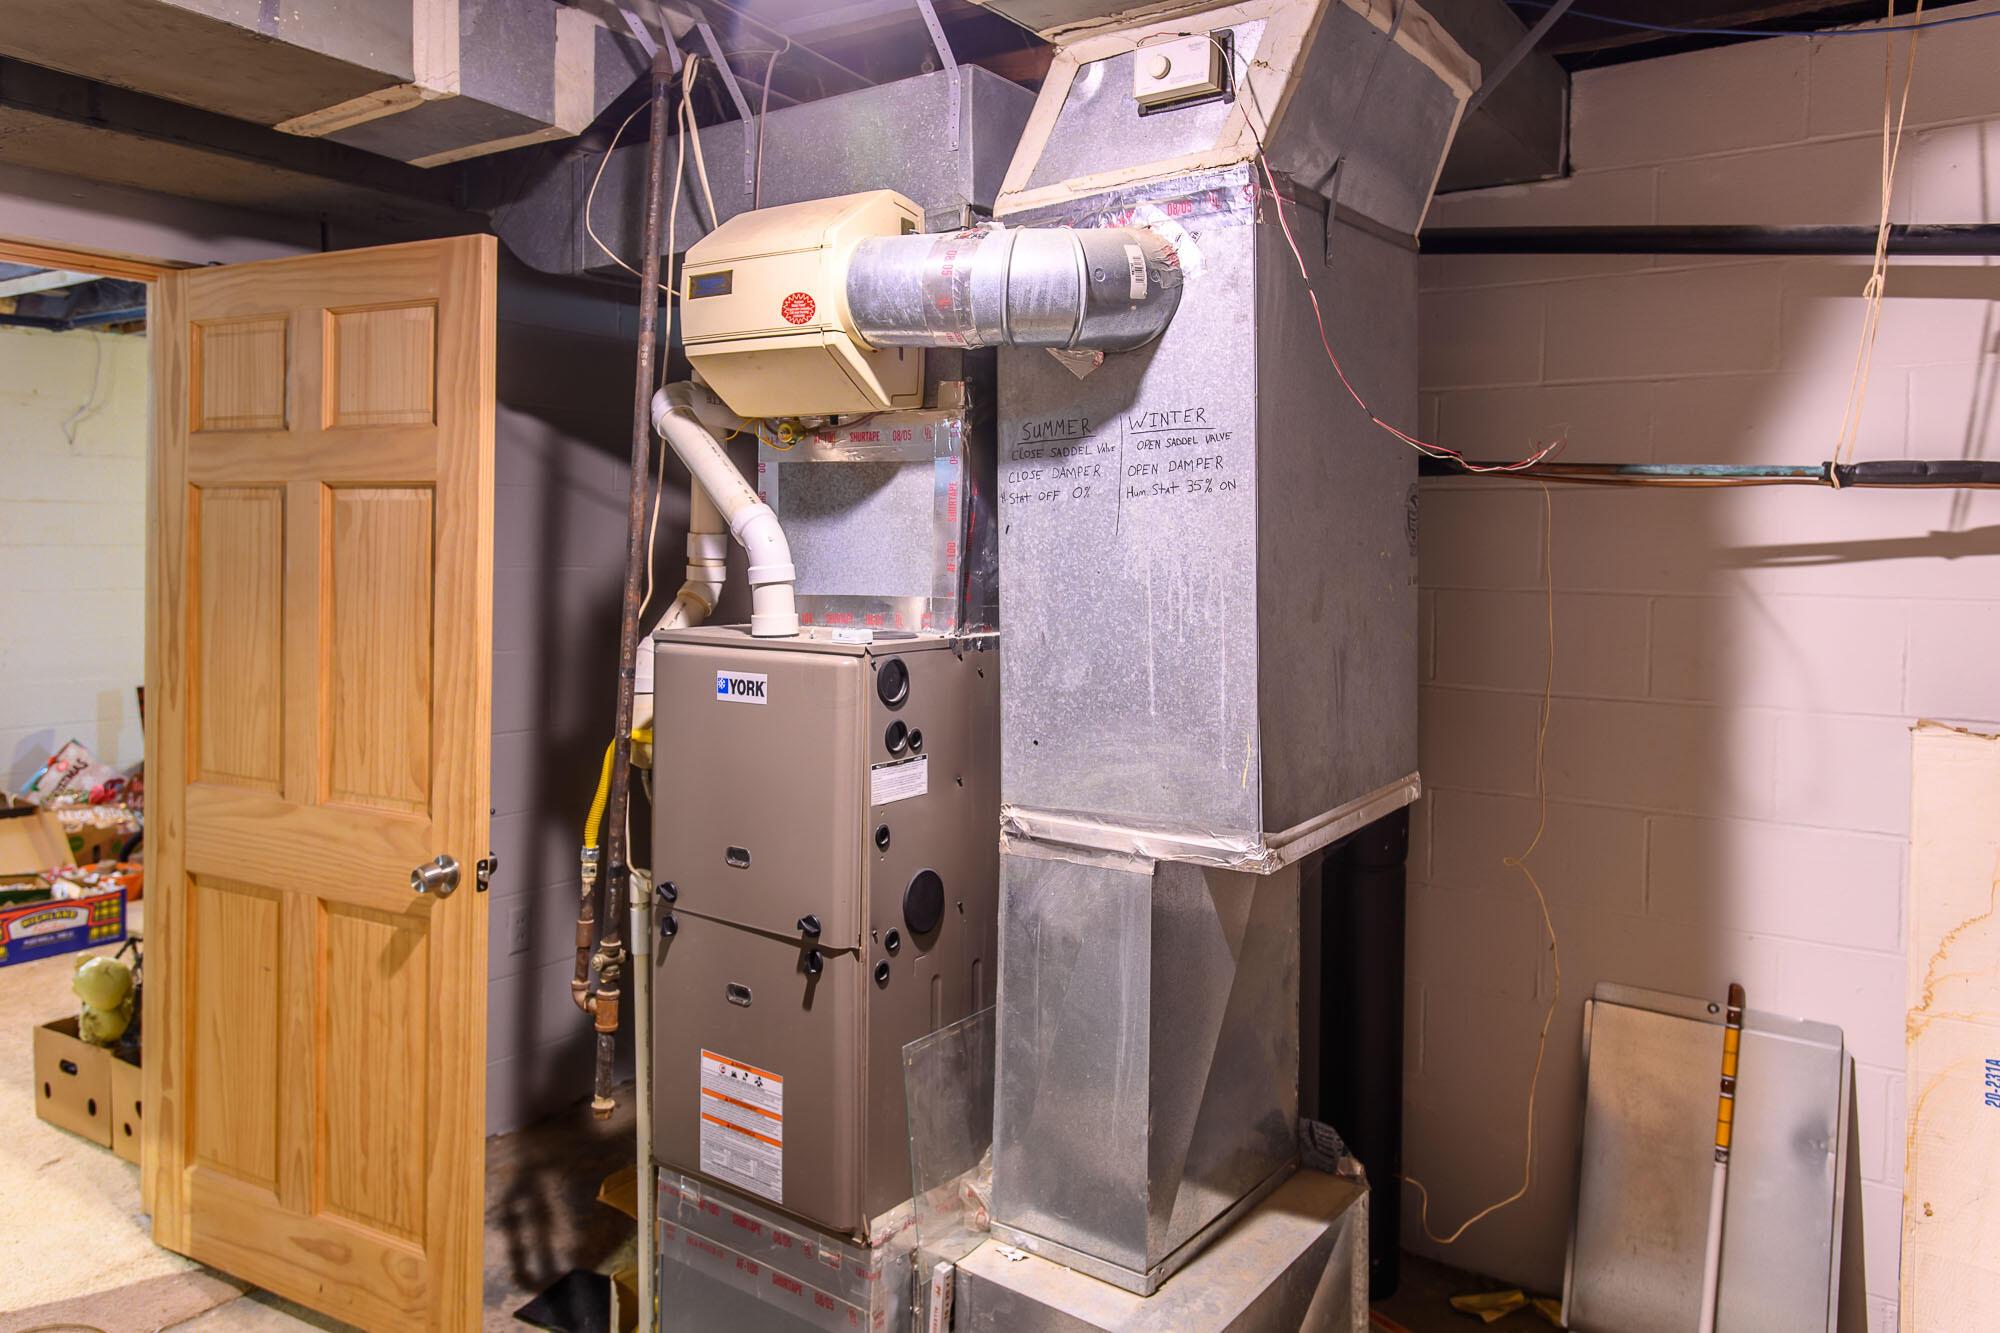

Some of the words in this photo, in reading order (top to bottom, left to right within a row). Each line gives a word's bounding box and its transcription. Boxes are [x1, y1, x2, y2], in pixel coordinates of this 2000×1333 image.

[1128, 407, 1207, 430] WINTER
[849, 431, 880, 442] SHURTAPE
[892, 429, 912, 441] 08/05
[1022, 417, 1092, 441] SUMMER
[1136, 439, 1161, 451] OPEN
[1165, 436, 1199, 448] SADDEL
[1205, 431, 1233, 444] VALVE
[1011, 448, 1044, 461] CLOSE
[1049, 445, 1092, 458] SADDEL
[1008, 470, 1043, 483] CLOSE
[1052, 464, 1101, 479] DAMPER
[1127, 463, 1159, 477] OPEN
[1168, 455, 1224, 472] DAMPER
[1038, 490, 1061, 501] OFF
[1072, 486, 1091, 499] 0%
[1152, 481, 1180, 495] Stat
[1187, 478, 1213, 493] 35%
[1219, 478, 1237, 491] ON
[947, 482, 957, 522] SHURTAPE
[729, 678, 765, 697] YORK
